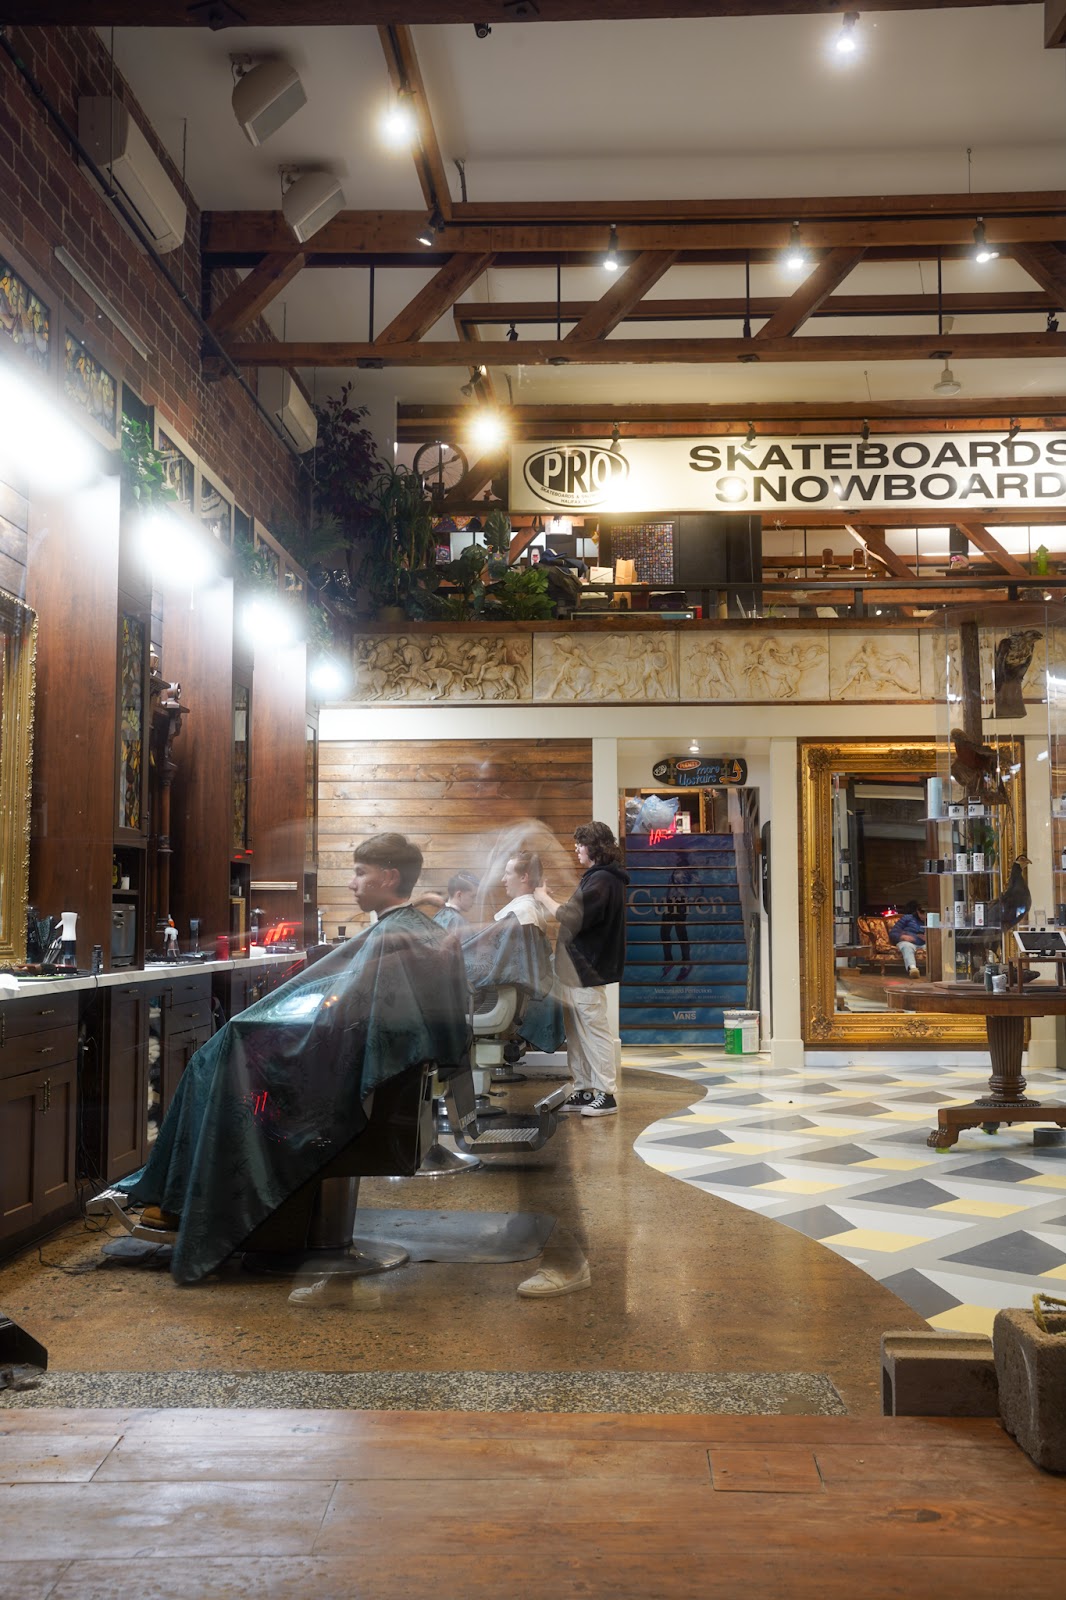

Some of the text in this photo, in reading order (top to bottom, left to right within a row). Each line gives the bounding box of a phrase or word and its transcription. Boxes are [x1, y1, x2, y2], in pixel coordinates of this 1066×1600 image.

[689, 439, 1066, 472] SKATEBOARDS
[543, 450, 612, 493] PRO
[540, 486, 575, 499] SKATEBOARDS
[697, 766, 720, 774] more
[680, 774, 717, 786] Upstairs
[628, 889, 728, 916] Curren
[673, 1011, 696, 1021] VANS
